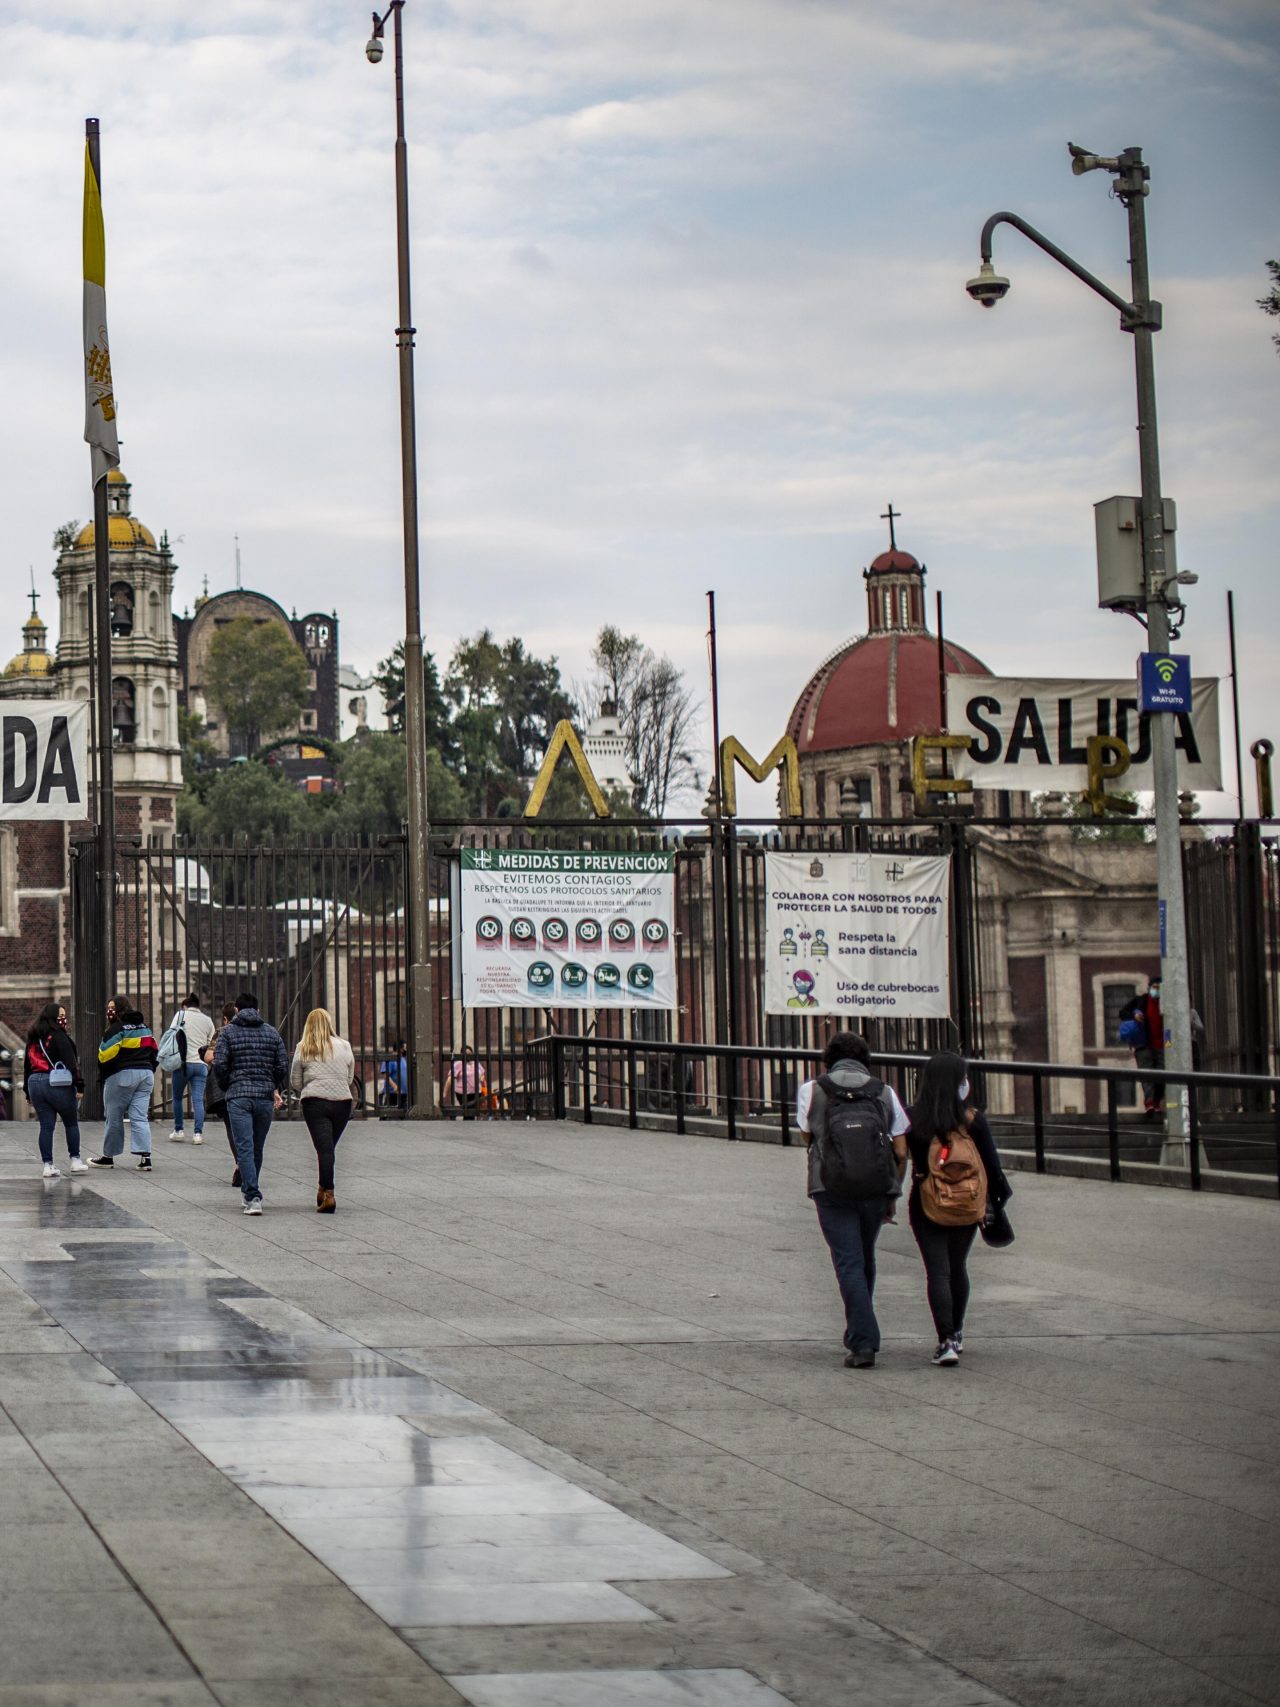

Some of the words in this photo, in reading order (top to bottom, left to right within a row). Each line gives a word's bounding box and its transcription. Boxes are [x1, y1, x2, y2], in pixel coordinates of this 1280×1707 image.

[1158, 688, 1177, 696] WI-FI
[1151, 696, 1184, 704] GRATUITO
[965, 695, 1202, 764] SALIDA
[498, 853, 560, 870] MEDIDAS
[563, 855, 581, 870] DE
[583, 852, 669, 871] PREVENCIÓN
[503, 873, 561, 885] EVITEMOS
[564, 874, 632, 886] CONTAGIOS
[474, 884, 529, 894] RESPETEMOS
[531, 886, 548, 895] LOS
[550, 886, 608, 895] PROTOCOLOS
[610, 887, 662, 896] SANITARIOS
[772, 891, 829, 901] COLABORA
[832, 893, 855, 901] CON
[858, 894, 912, 903] NOSOTROS
[914, 896, 942, 904] PARA
[777, 903, 831, 912] PROTEGER
[834, 904, 848, 912] LA
[850, 904, 884, 914] SALUD
[886, 906, 899, 914] DE
[902, 906, 938, 915] TODOS
[838, 932, 884, 945] Respeta
[886, 933, 896, 942] la
[838, 946, 866, 955] sana
[869, 944, 918, 956] distancia
[837, 982, 859, 991] Uso
[861, 982, 875, 992] de
[877, 982, 940, 993] cubrebocas
[836, 994, 896, 1006] obligatorio
